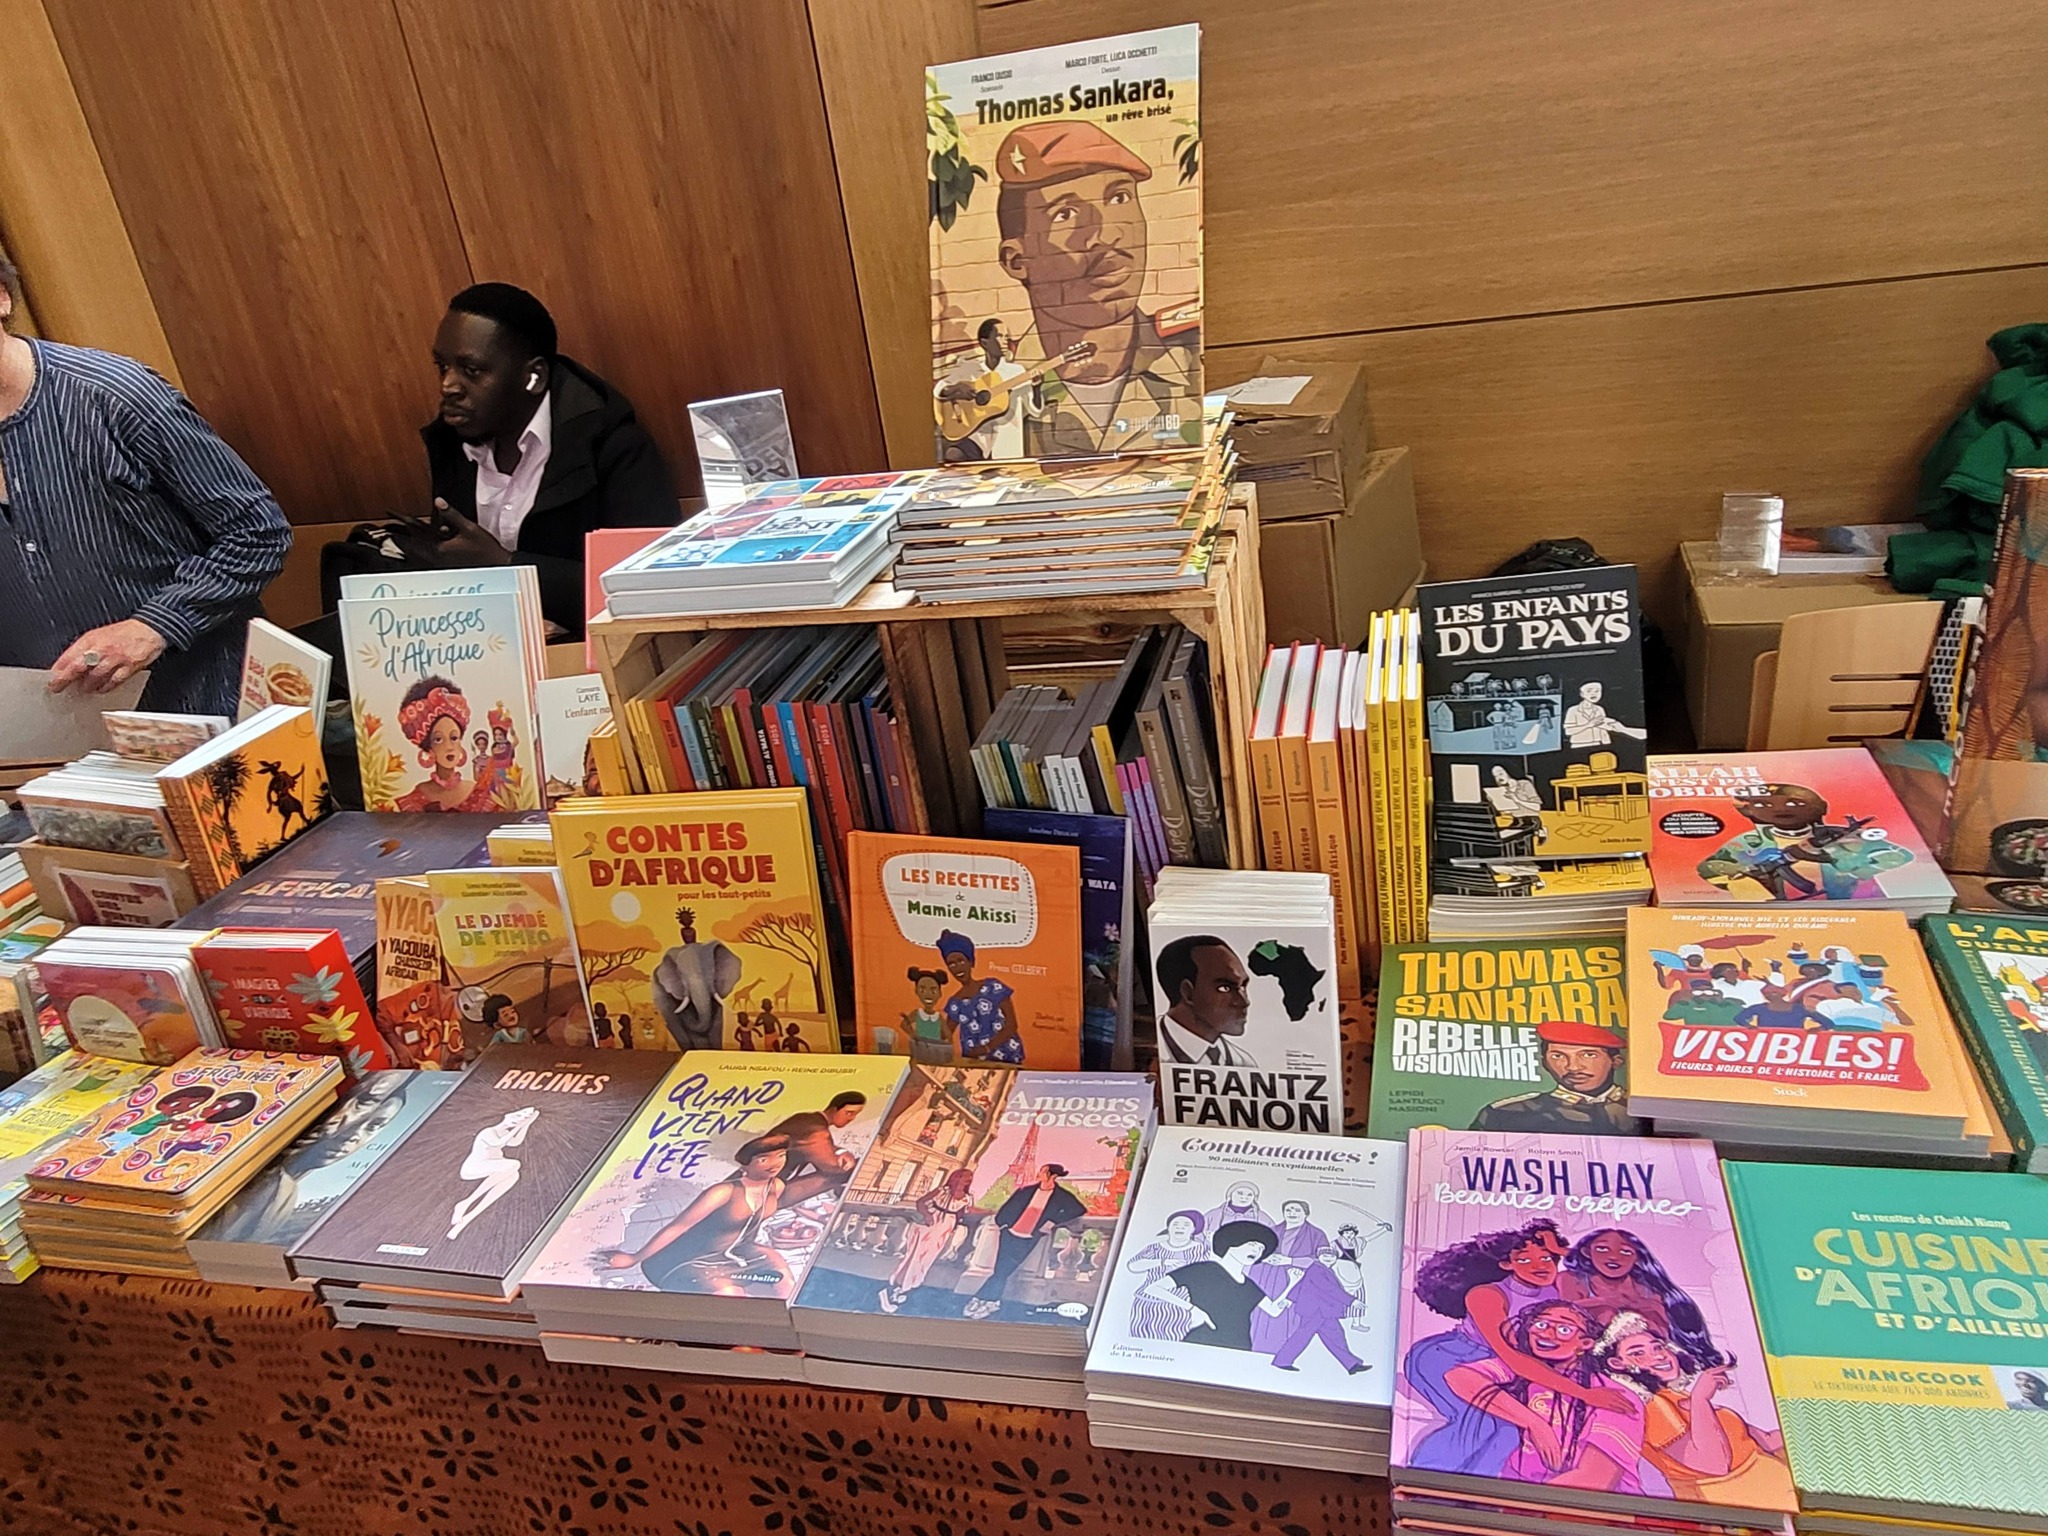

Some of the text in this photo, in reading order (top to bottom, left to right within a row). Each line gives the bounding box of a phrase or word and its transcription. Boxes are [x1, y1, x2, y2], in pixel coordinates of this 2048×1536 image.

[1065, 57, 1087, 68] MARCO
[1110, 51, 1127, 62] LUCA
[976, 77, 1174, 125] Thomas Sankara,
[1106, 103, 1172, 123] un rêve brisé
[1434, 603, 1485, 627] LES
[1491, 589, 1629, 621] ENFANTS
[369, 607, 485, 648] Princesses
[1435, 621, 1508, 658] DU
[1516, 610, 1632, 651] PAYS
[384, 639, 485, 682] d'Afrique
[578, 693, 601, 704] LAYE
[564, 706, 598, 719] L'enfant
[769, 723, 781, 746] MOSS
[819, 723, 831, 746] MOSS
[1650, 766, 1761, 778] ALLAH
[1717, 777, 1767, 786] PAS
[606, 822, 748, 854] CONTES
[1328, 833, 1339, 878] d'Afrique
[589, 855, 777, 889] D'AFRIQUE
[901, 868, 1020, 892] LES RECETTES
[1087, 878, 1117, 892] WATA
[1397, 890, 1406, 898] LA
[1414, 888, 1424, 897] LA
[677, 889, 772, 902] pour les tout-petits
[955, 891, 966, 902] de
[1380, 891, 1389, 900] LA
[1381, 901, 1390, 910] DE
[1398, 898, 1406, 906] DE
[1415, 897, 1424, 906] DE
[455, 911, 549, 930] LE DJEMBÉ
[907, 899, 1017, 925] Mamie Akissi
[1381, 910, 1391, 922] FOU
[1398, 907, 1407, 919] FOU
[1415, 906, 1424, 918] FOU
[458, 930, 487, 947] DE
[385, 965, 419, 981] AFRICAIN
[1011, 964, 1047, 977] GILBERT
[1398, 946, 1624, 996] THOMAS
[1395, 977, 1628, 1028] SANKARA
[1392, 1017, 1539, 1057] REBELLE
[1672, 1028, 1905, 1072] VISIBLES!
[184, 1066, 281, 1082] AFRICAINES
[1392, 1046, 1542, 1082] VISIONNAIRE
[1670, 1060, 1901, 1083] FIGURES NOIRES DE L'HISTOIRE DE FRANCE
[494, 1068, 610, 1095] RACINES
[1171, 1066, 1329, 1102] FRANTZ
[668, 1072, 786, 1112] QUAND
[1007, 1090, 1141, 1112] Amours
[1388, 1097, 1446, 1105] SANTUCCI
[1389, 1089, 1425, 1097] LEPIDI
[1772, 1086, 1808, 1098] Stock
[999, 1108, 1140, 1128] croisées
[1174, 1094, 1331, 1134] FANON
[648, 1109, 766, 1140] VIENT
[1180, 1136, 1379, 1165] Combattantes !
[1527, 1148, 1556, 1156] Robyn
[1221, 1156, 1270, 1167] militantes
[1270, 1160, 1346, 1173] exceptionnelles
[1461, 1155, 1656, 1201] WASH DAY
[1433, 1182, 1703, 1221] Beautés crépues
[1851, 1210, 2011, 1231] Les recettes de Cheikh Niang
[1873, 1312, 2048, 1339] ET D'AILLEU
[1133, 1352, 1176, 1363] Martinière
[1842, 1367, 1986, 1387] NIANGCOOK
